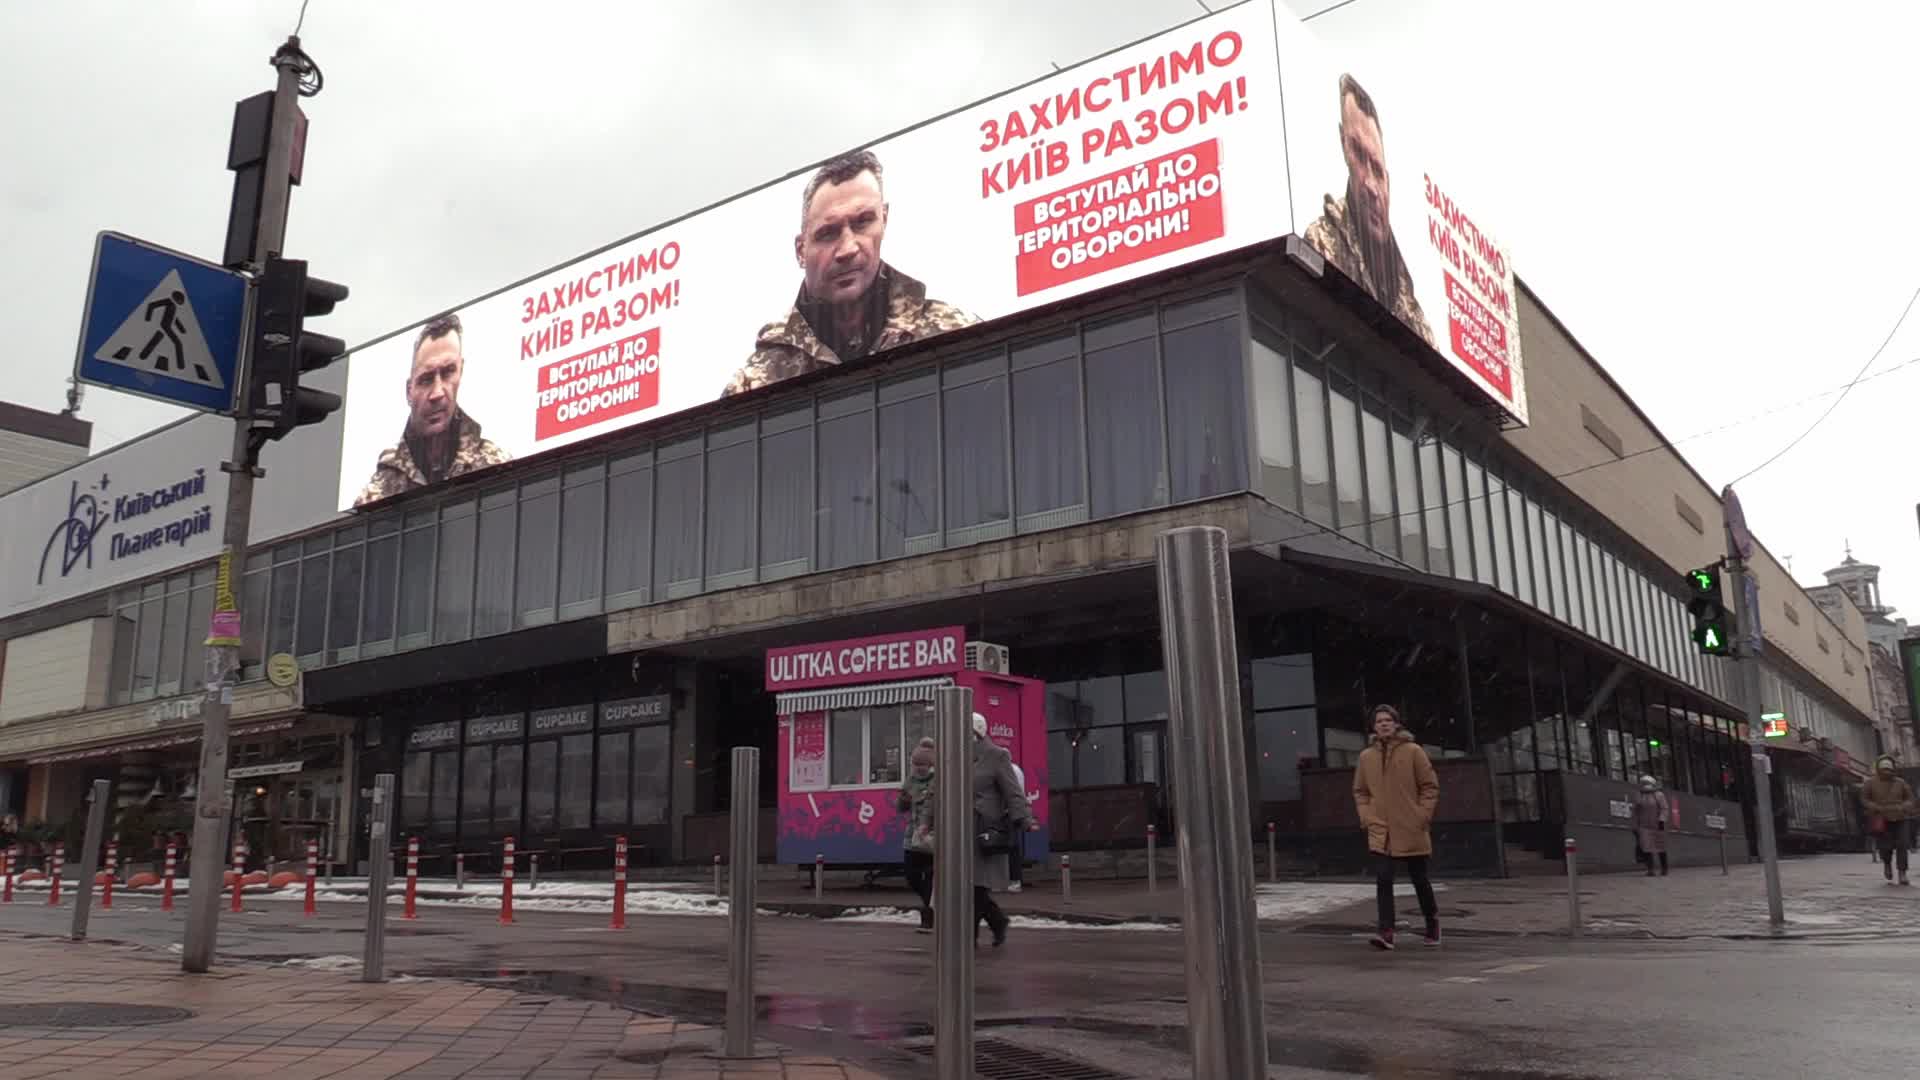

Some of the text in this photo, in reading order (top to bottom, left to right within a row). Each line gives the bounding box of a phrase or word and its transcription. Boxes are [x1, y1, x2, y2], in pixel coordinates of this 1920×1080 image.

[980, 31, 1243, 153] ЗАХИСТИМО
[982, 76, 1248, 199] КИЇВ РАЗОМ!
[1033, 152, 1198, 224] ВСТУПАЙ ДО
[1051, 208, 1190, 270] ОБОРОНИ!
[1423, 171, 1506, 280] ЗАХИСТИМО
[521, 241, 681, 324] ЗАХИСТИМО
[1428, 214, 1511, 321] КИЇВ РАЗОМ!
[520, 279, 680, 361] КИЇВ РАЗОМ!
[549, 337, 647, 384] ВСТУПАЙ ДО
[556, 381, 640, 422] ОБОРОНИ!
[113, 468, 205, 524] Київський
[109, 505, 211, 561] Планетарій
[770, 636, 957, 683] ULITKA COFFEE BAR
[410, 727, 456, 744] CUPCAKE
[470, 719, 519, 737] CUPCAKE
[535, 711, 588, 729] CUPCAKE
[605, 702, 662, 721] CUPCAKE
